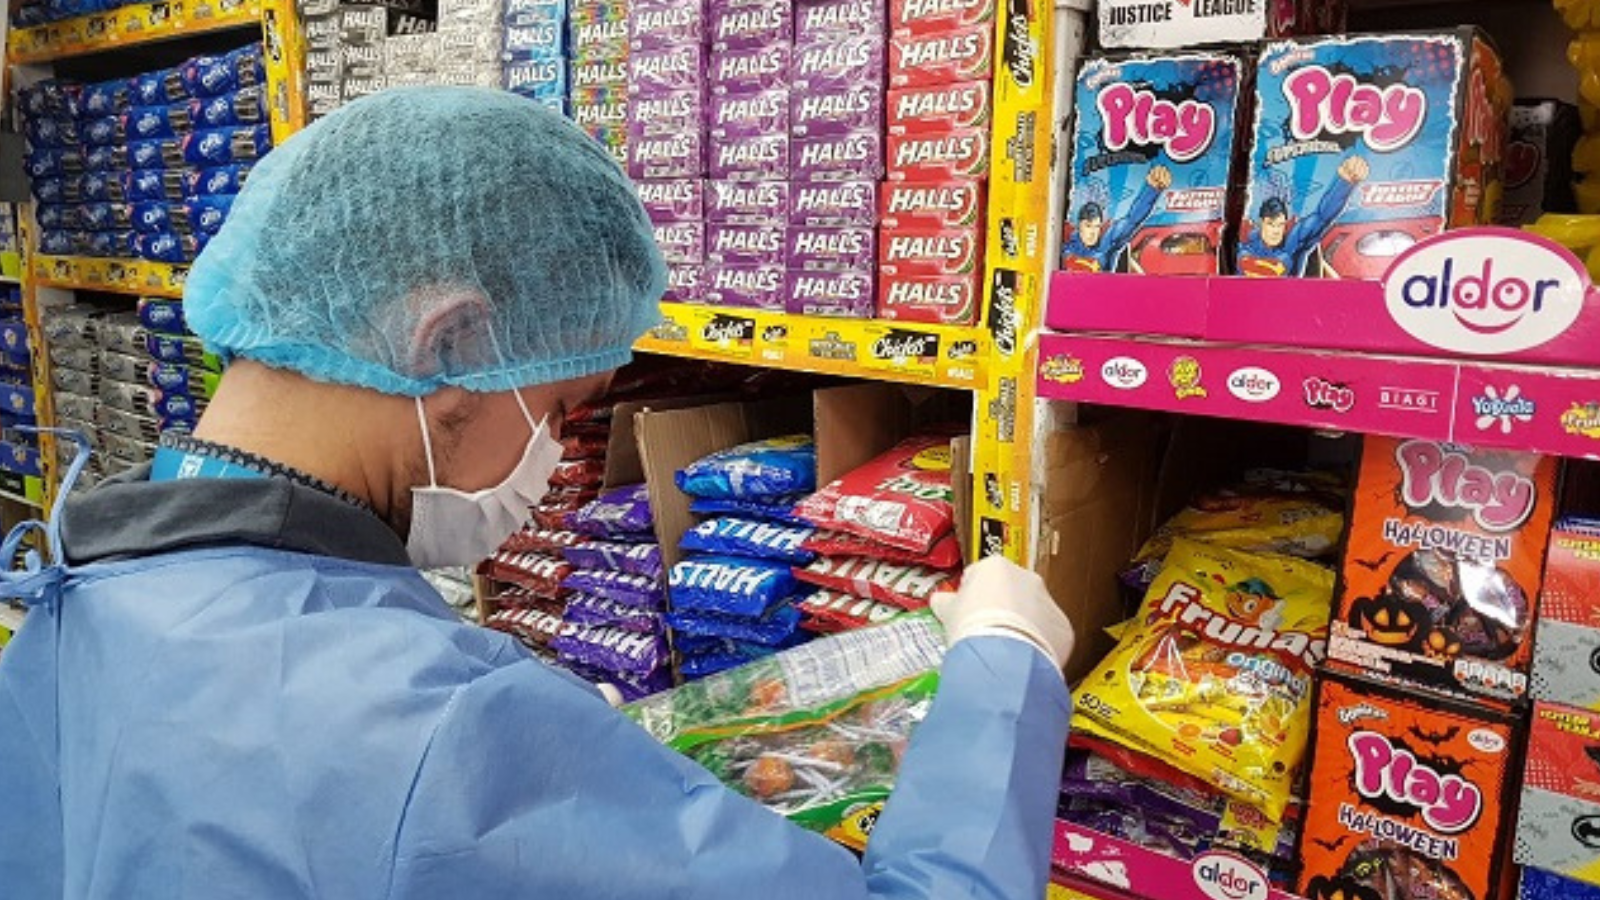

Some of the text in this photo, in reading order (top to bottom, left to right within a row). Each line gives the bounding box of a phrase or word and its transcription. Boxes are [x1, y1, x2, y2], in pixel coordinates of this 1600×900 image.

[636, 6, 692, 35] HALLS
[719, 6, 784, 38] HALLS
[805, 1, 872, 30] HALLS
[1109, 0, 1255, 25] JUSTICE LEAGUE
[577, 19, 628, 46] HALLS
[633, 51, 690, 79] HALLS
[800, 44, 870, 75] HALLS
[901, 34, 978, 68] HALLS
[509, 64, 556, 89] HALLS
[575, 62, 627, 87] HALLS
[719, 52, 781, 80] HALLS
[575, 102, 627, 124] HALLS
[636, 96, 690, 122] HALLS
[718, 96, 780, 124] HALLS
[800, 91, 870, 121] HALLS
[897, 90, 975, 119] HALLS
[1283, 66, 1426, 151] Play
[1098, 83, 1214, 161] Play
[635, 138, 690, 162] HALLS
[719, 142, 779, 167] HALLS
[800, 139, 868, 167] HALLS
[897, 138, 974, 166] HALLS
[638, 182, 693, 203] HALLS
[717, 187, 779, 210] HALLS
[797, 188, 865, 212] HALLS
[889, 188, 965, 213] HALLS
[654, 227, 694, 245] ALLS
[717, 229, 780, 251] HALLS
[795, 231, 862, 255] HALLS
[888, 237, 962, 261] HALLS
[714, 269, 778, 291] HALLS
[793, 277, 861, 300] HALLS
[887, 282, 961, 305] HALLS
[1401, 257, 1559, 312] aldor
[1104, 362, 1142, 378] aldor
[1230, 374, 1274, 391] aldor
[1303, 376, 1354, 412] Play
[1380, 391, 1437, 408] BIAGI
[1397, 440, 1534, 532] Play
[1384, 519, 1510, 559] HALLOWEEN
[669, 561, 777, 595] HALLS
[1159, 583, 1326, 669] Frunas
[1348, 731, 1481, 832] Play
[1338, 803, 1459, 860] HALLOWEEN
[1199, 862, 1259, 894] aldor
